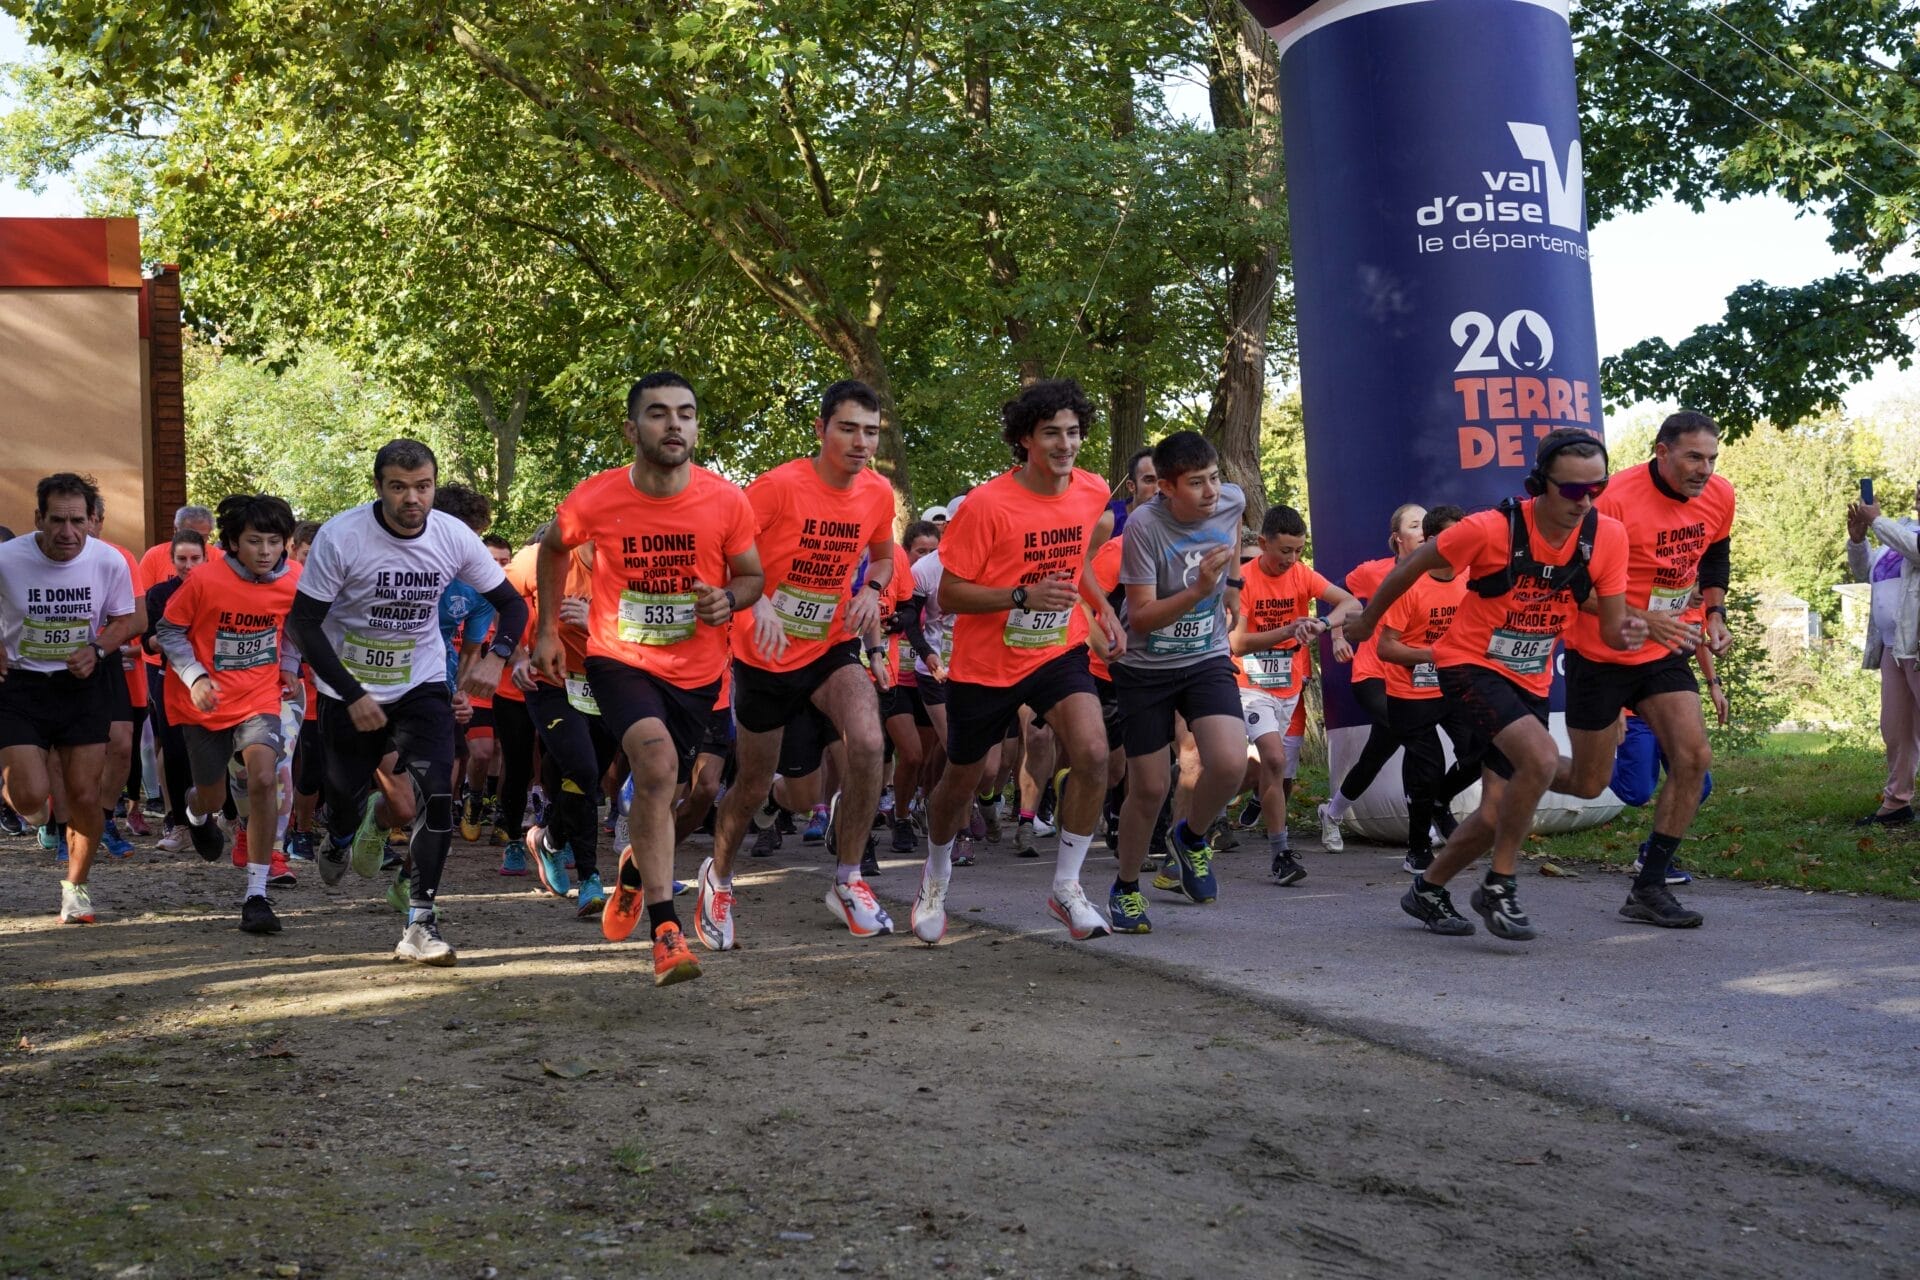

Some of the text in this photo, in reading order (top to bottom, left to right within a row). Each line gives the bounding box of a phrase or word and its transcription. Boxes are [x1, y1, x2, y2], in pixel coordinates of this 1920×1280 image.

[1482, 166, 1540, 193] val
[1418, 235, 1444, 253] le
[1454, 376, 1591, 423] TERRE
[1458, 425, 1525, 469] DE
[802, 518, 861, 539] JE DONNE
[623, 534, 696, 553] JE DONNE
[1024, 525, 1082, 548] JE DONNE
[1656, 531, 1667, 546] JE
[799, 537, 858, 553] MON SOUFFLE
[1656, 546, 1674, 558] MON
[810, 552, 841, 563] POUR LA
[1024, 544, 1081, 562] MON SOUFFLE
[624, 554, 696, 568] MON SOUFFLE
[791, 559, 849, 577] VIRADE DE
[1037, 559, 1067, 571] POUR LA
[376, 572, 440, 587] JE DONNE
[643, 569, 668, 580] POUR
[28, 587, 91, 602] JE DONNE
[375, 589, 398, 600] MON
[627, 580, 678, 595] VIRADE
[28, 603, 91, 614] MON SOUFFLE
[794, 601, 820, 621] 551
[1256, 599, 1294, 609] JE DONNE
[1543, 604, 1551, 612] LA
[219, 612, 276, 627] JE DONNE
[371, 606, 416, 620] VIRADE
[644, 605, 674, 624] 533
[1430, 608, 1438, 617] JE
[1506, 611, 1547, 627] VIRADE
[1032, 612, 1057, 629] 572
[43, 630, 70, 643] 563
[1174, 622, 1200, 637] 895
[237, 640, 262, 655] 829
[1511, 641, 1539, 657] 846
[365, 649, 395, 667] 505
[1262, 659, 1279, 672] 778
